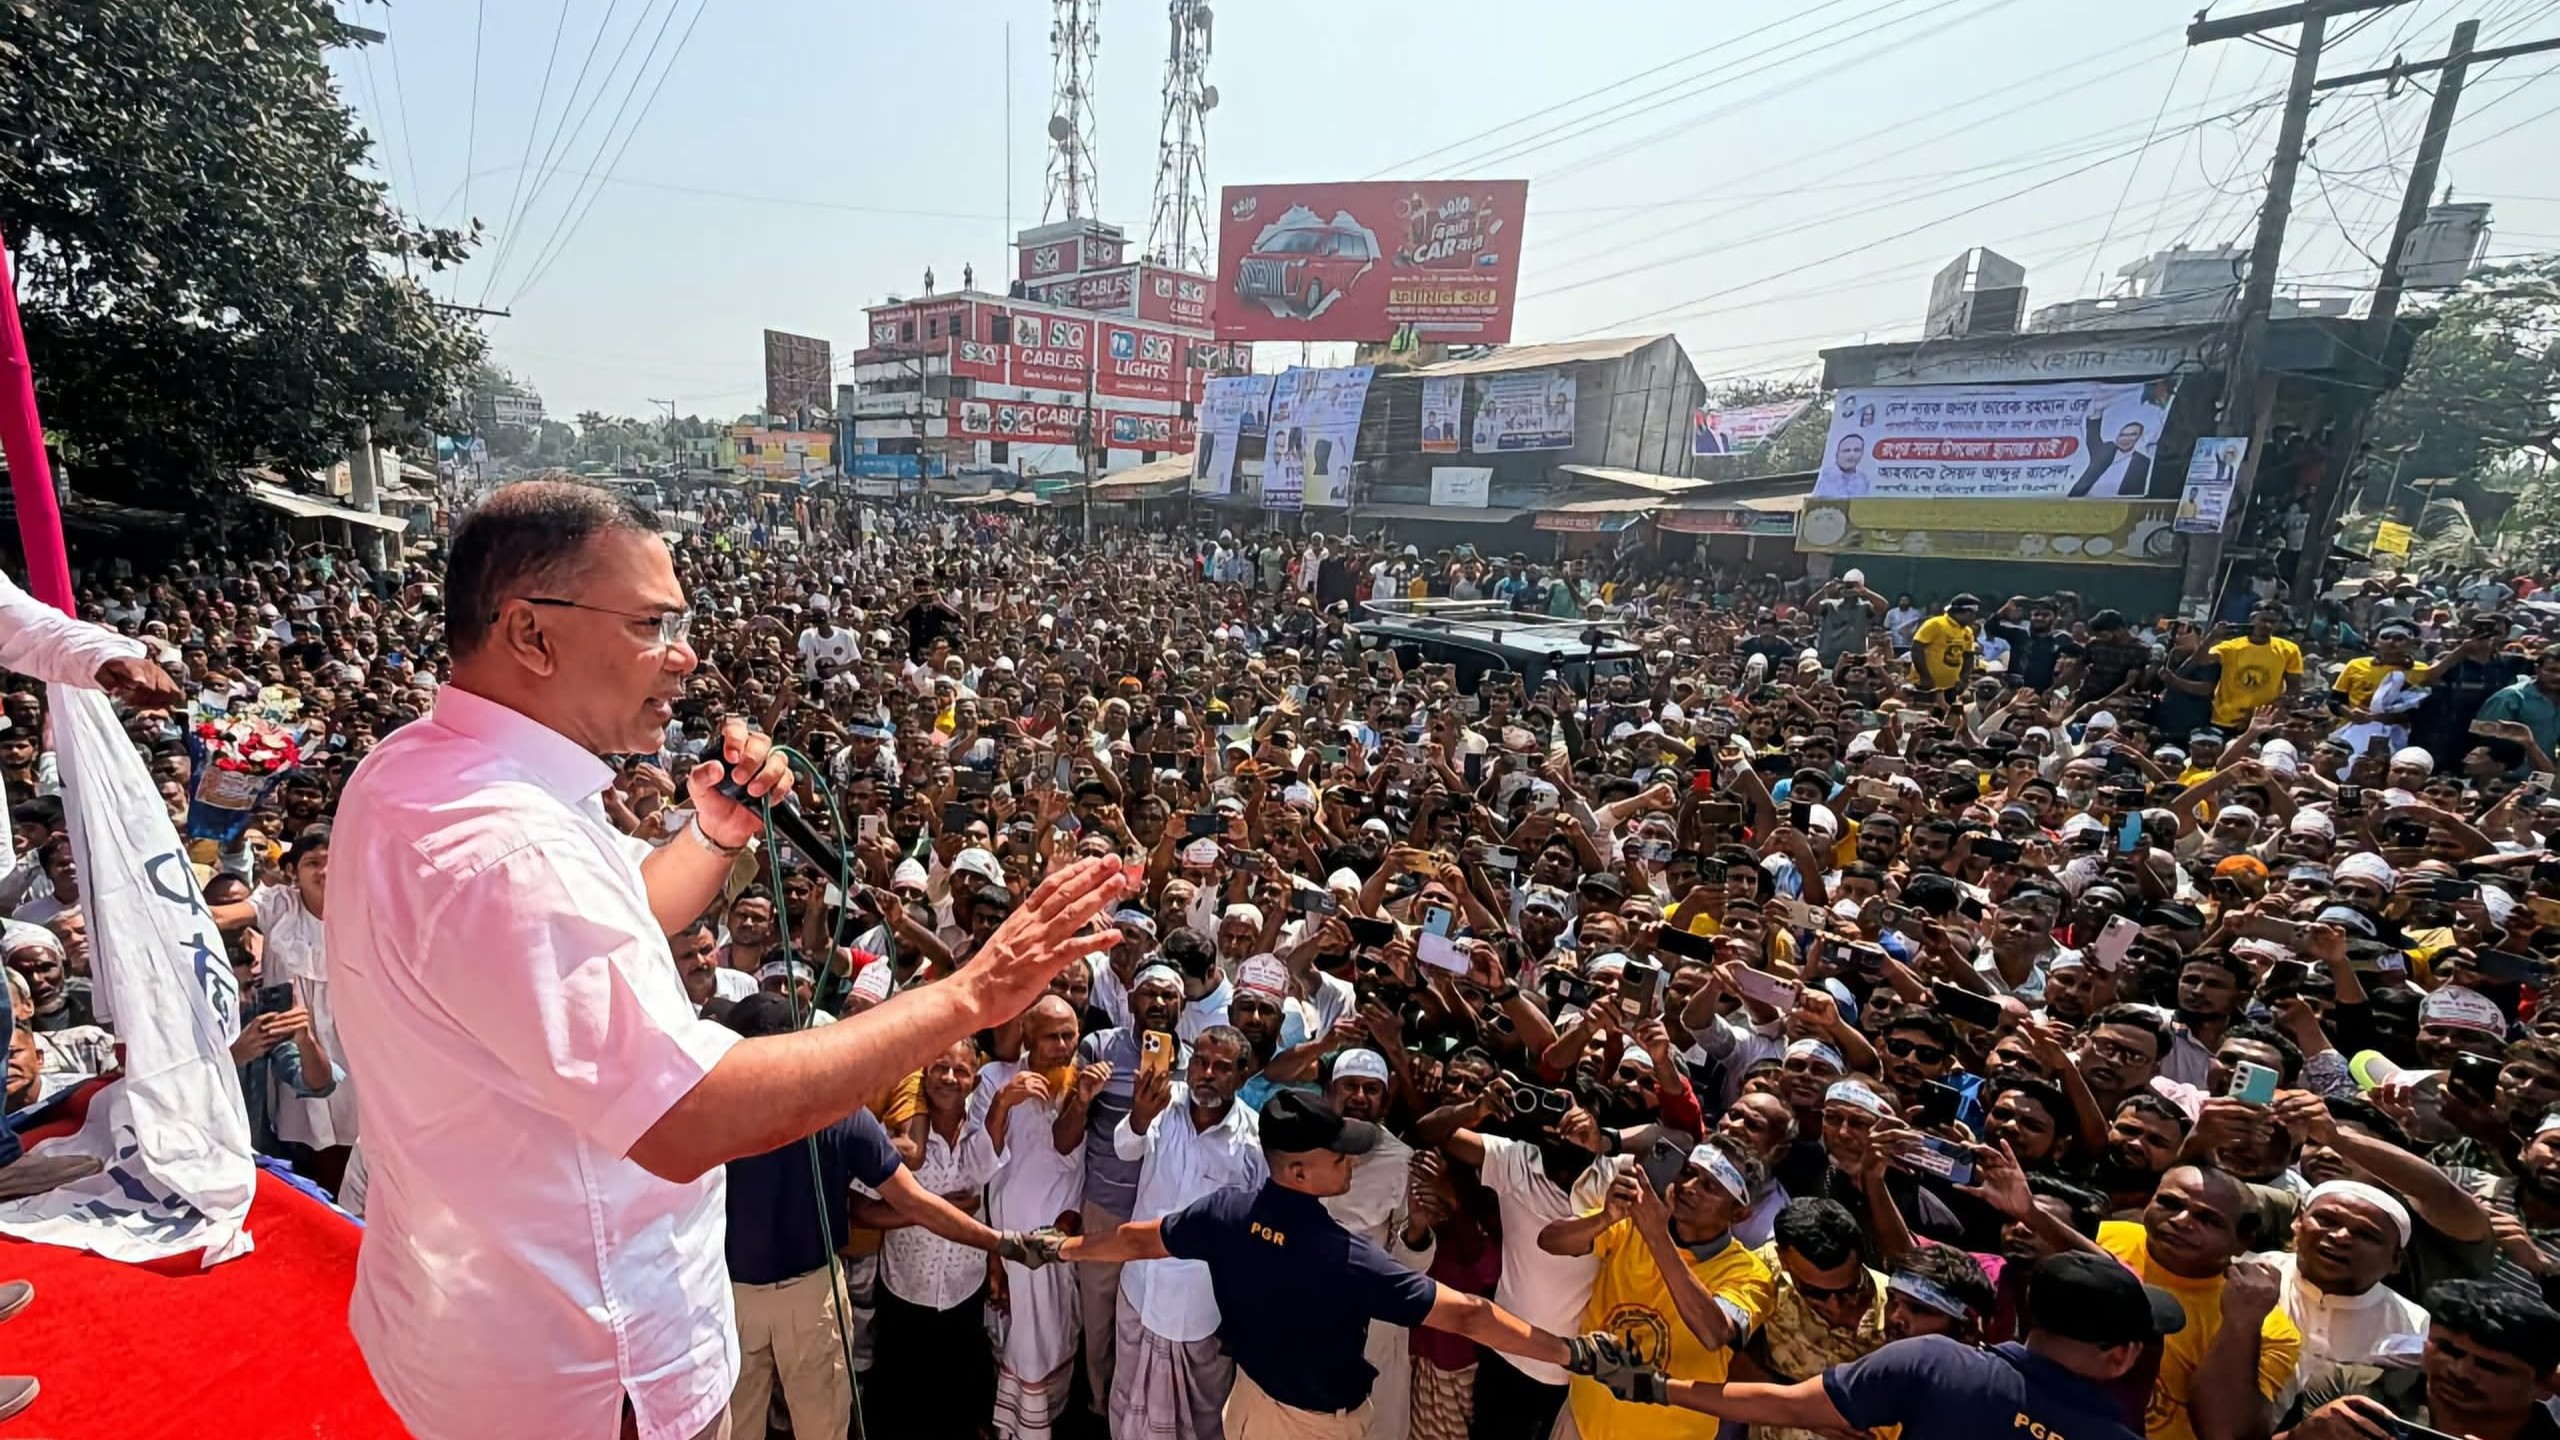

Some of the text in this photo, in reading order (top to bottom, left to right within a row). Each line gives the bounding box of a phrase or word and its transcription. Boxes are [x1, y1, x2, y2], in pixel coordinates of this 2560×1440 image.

[1034, 250, 1059, 273] SQ
[1081, 275, 1131, 298] CABLES
[1179, 281, 1206, 303] SQ
[1170, 301, 1203, 316] CABLES
[1051, 321, 1084, 349] SQ
[962, 344, 997, 364] SQ
[1021, 348, 1085, 370] CABLES
[1143, 336, 1174, 362] SQ
[1115, 359, 1169, 380] LIGHTS
[1982, 400, 2022, 416] তারেক
[2026, 399, 2067, 415] রহমান
[999, 408, 1035, 433] SQ
[1250, 1221, 1286, 1247] PGR
